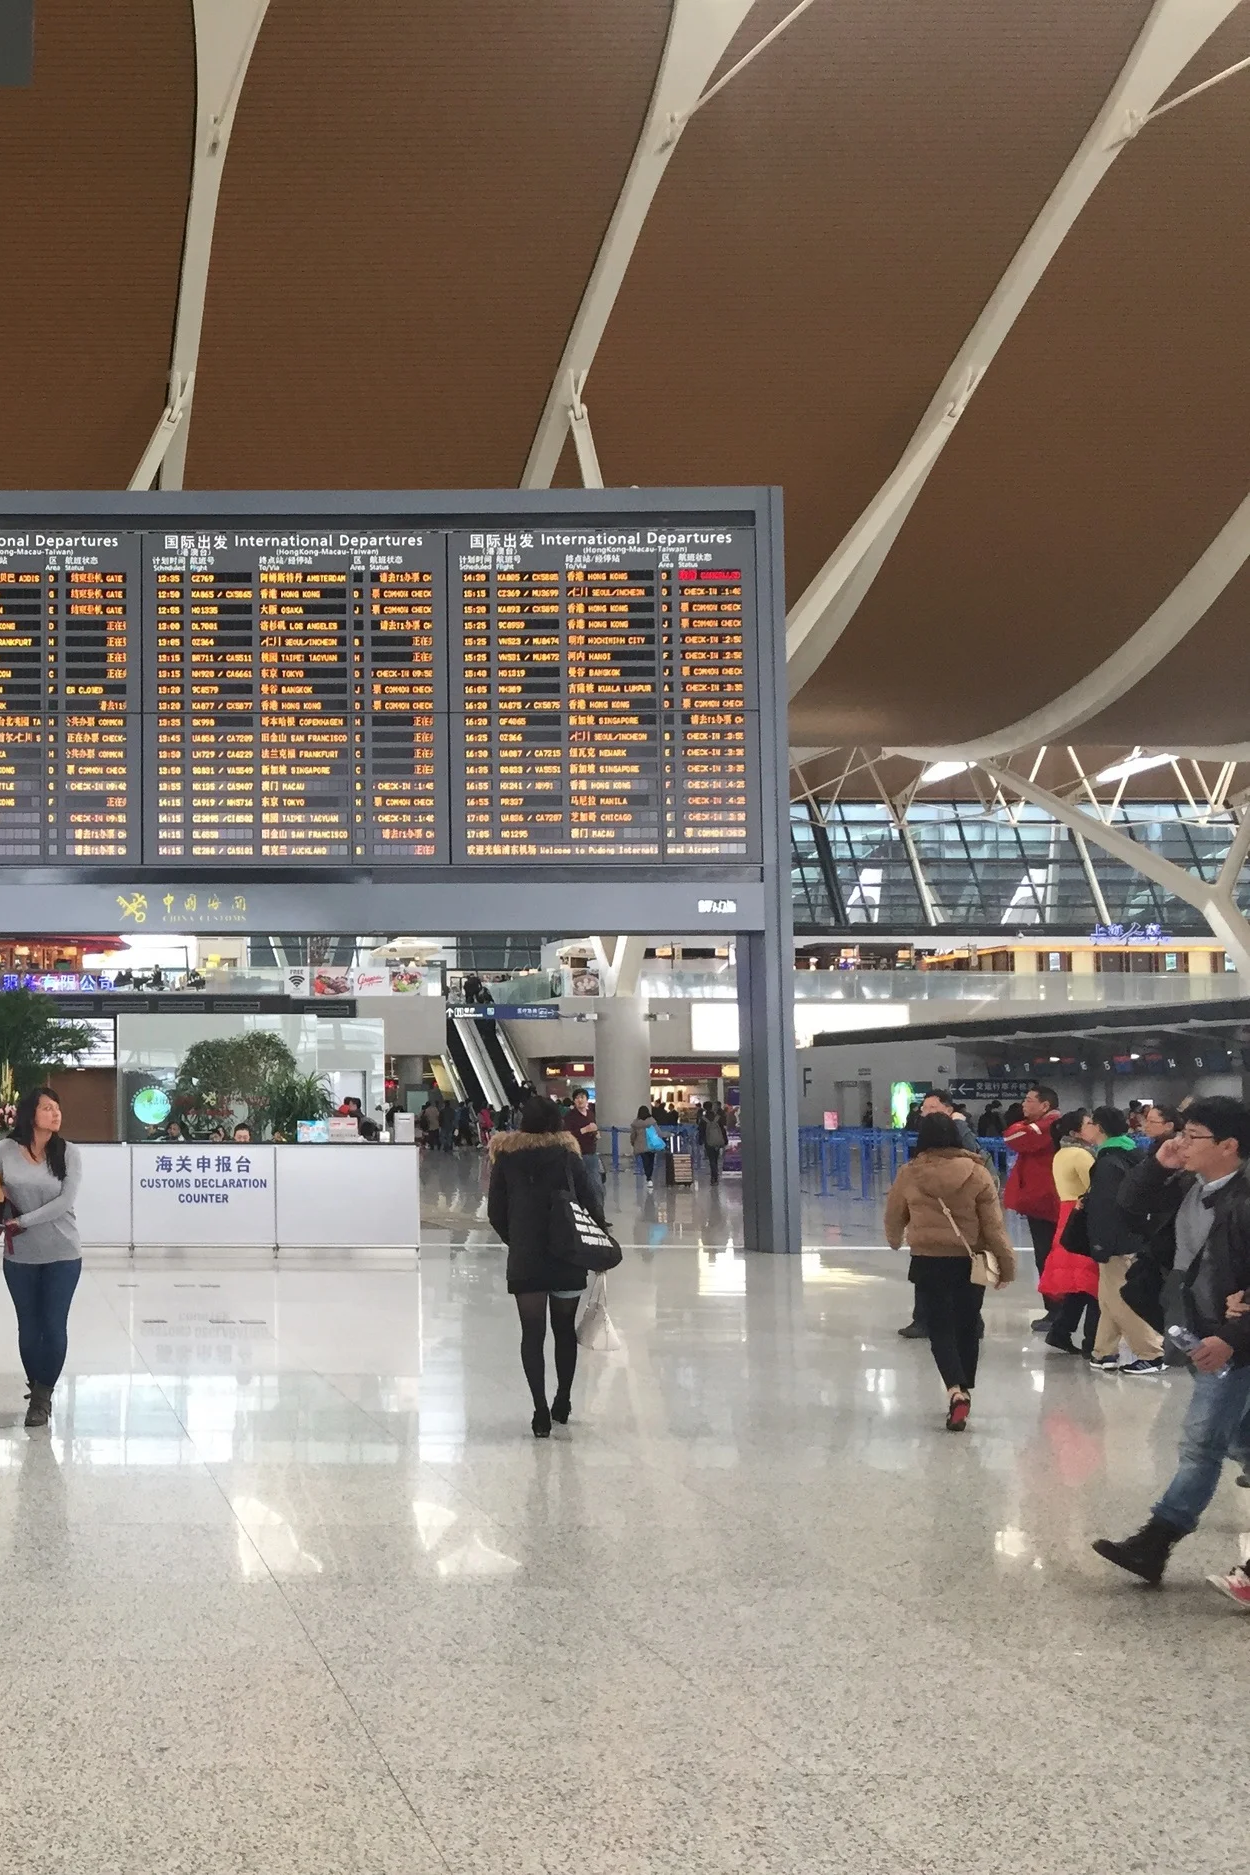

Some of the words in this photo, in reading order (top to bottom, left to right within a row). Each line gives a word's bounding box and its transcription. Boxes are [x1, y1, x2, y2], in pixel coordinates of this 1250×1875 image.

[36, 535, 118, 549] Departures
[165, 534, 228, 550] 国际出发
[235, 534, 332, 546] International
[340, 535, 423, 549] Departures
[470, 533, 534, 548] 国际出发
[541, 532, 640, 546] International
[647, 532, 732, 546] Departures
[49, 556, 57, 564] 区
[65, 556, 98, 565] 航班状态
[190, 557, 214, 565] 航班号
[354, 556, 362, 564] 区
[370, 556, 403, 564] 航班状态
[496, 555, 521, 564] 航班号
[662, 554, 670, 562] 区
[678, 553, 712, 562] 航班状态
[1195, 1057, 1203, 1068] 13
[803, 1068, 812, 1098] F
[155, 1155, 251, 1173] 海关申报台
[140, 1178, 191, 1188] CUSTOMS
[194, 1178, 267, 1188] DECLARATION
[178, 1194, 229, 1203] COUNTER
